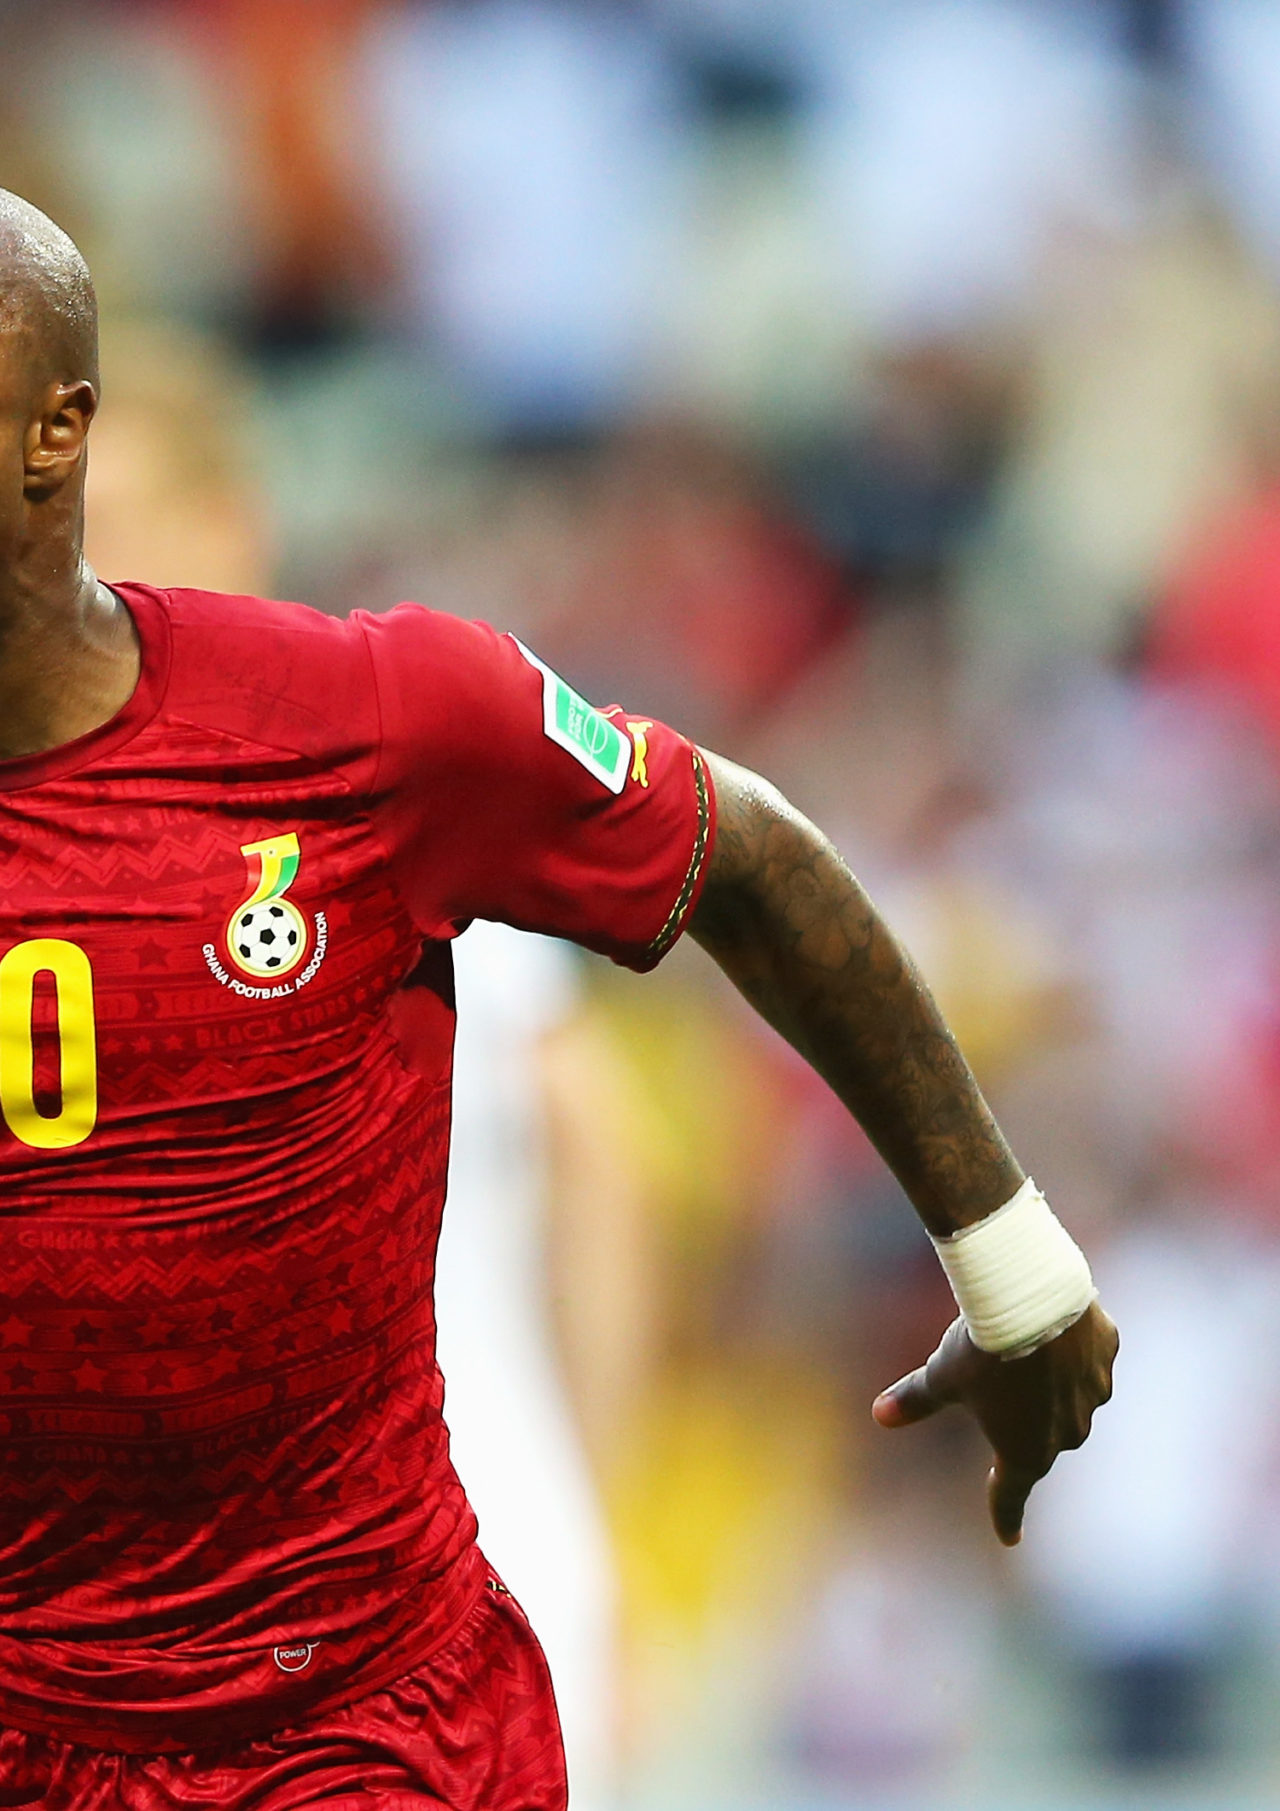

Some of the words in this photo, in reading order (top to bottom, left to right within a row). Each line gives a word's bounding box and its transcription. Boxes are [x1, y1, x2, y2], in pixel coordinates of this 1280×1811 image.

[202, 944, 229, 984] GHANA
[228, 980, 294, 999] FOOTBALL
[295, 911, 327, 990] ASSOCIATION
[196, 1016, 283, 1049] BLACK
[289, 995, 348, 1030] STARS
[279, 1648, 307, 1659] POWER
